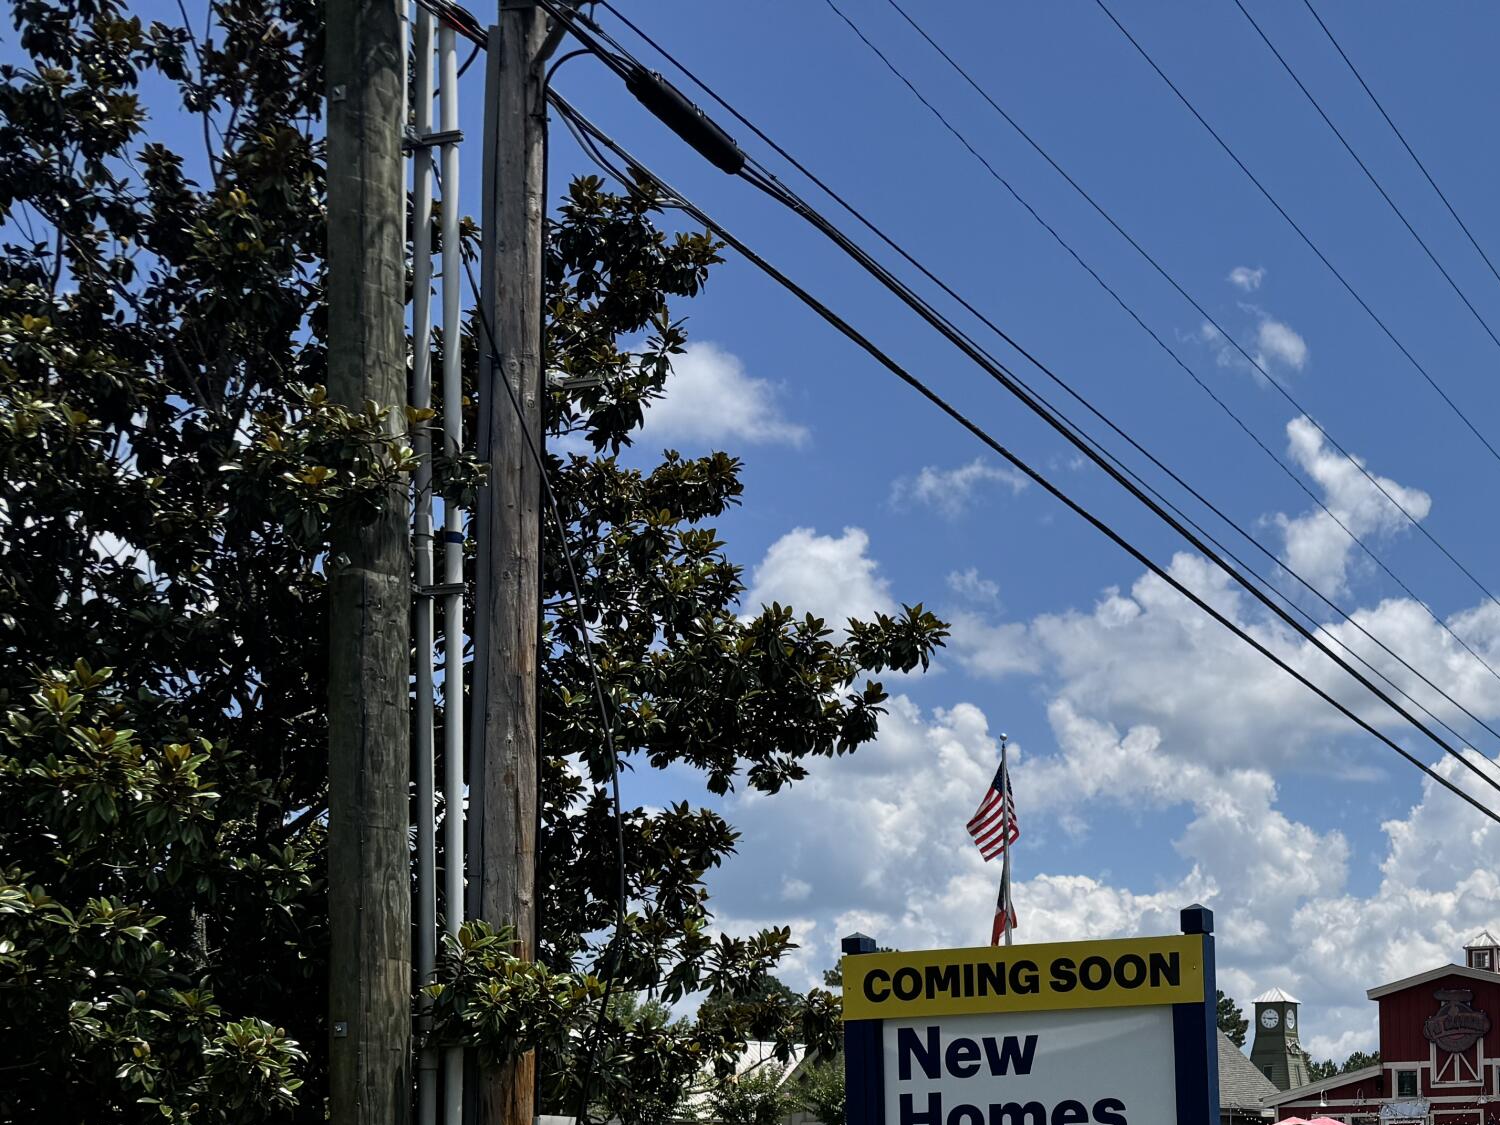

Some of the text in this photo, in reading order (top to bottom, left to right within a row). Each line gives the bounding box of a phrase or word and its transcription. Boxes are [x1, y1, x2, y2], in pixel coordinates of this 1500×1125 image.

[863, 951, 1181, 1003] COMING SOON
[897, 1025, 1039, 1081] New
